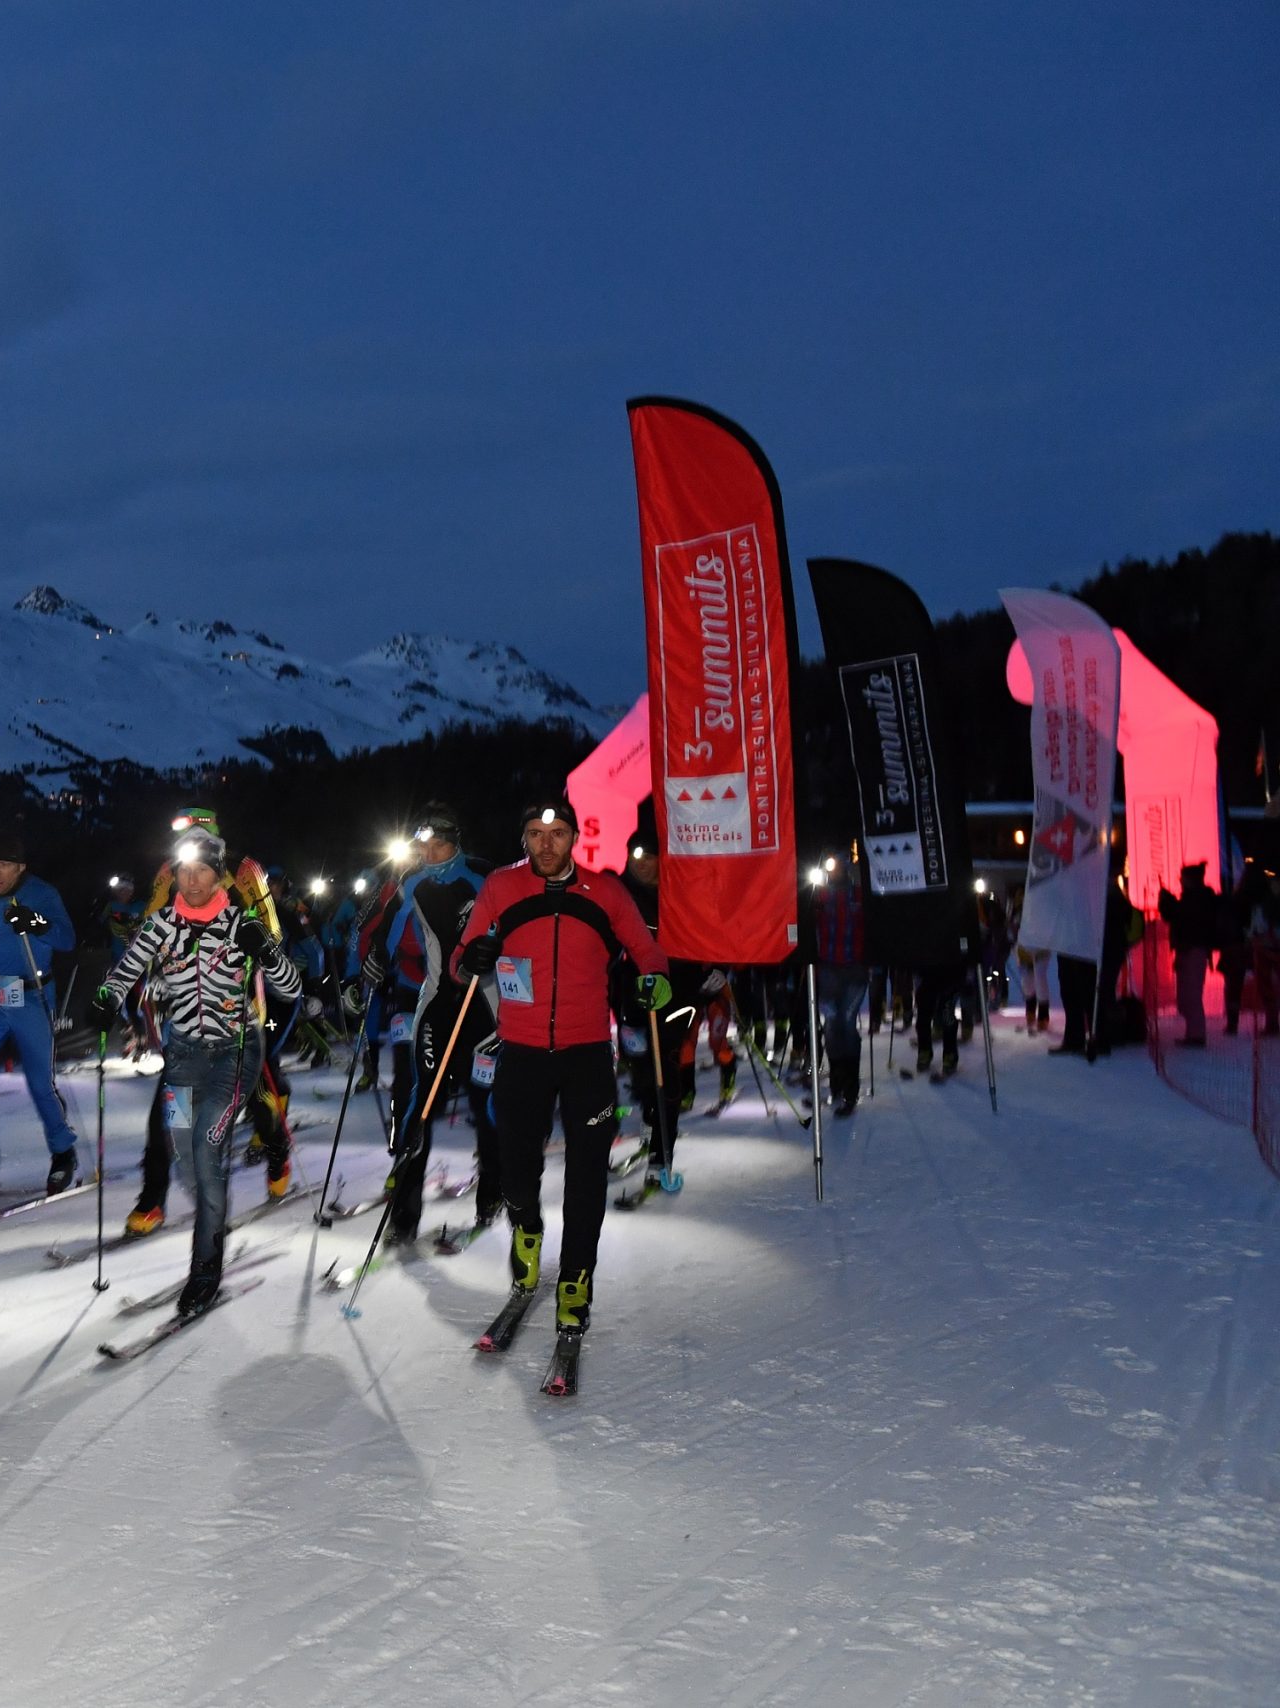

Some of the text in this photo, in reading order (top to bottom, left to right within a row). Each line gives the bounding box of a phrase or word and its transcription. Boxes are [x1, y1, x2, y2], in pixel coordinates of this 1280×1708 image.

[684, 549, 735, 732] summits
[738, 536, 769, 843] PONTRESINA-SILVAPLANA
[862, 670, 910, 805] summits
[676, 823, 721, 834] skimo
[677, 831, 744, 843] verticals
[11, 988, 19, 1004] 101
[502, 981, 519, 994] 141
[423, 1022, 436, 1070] CAMP
